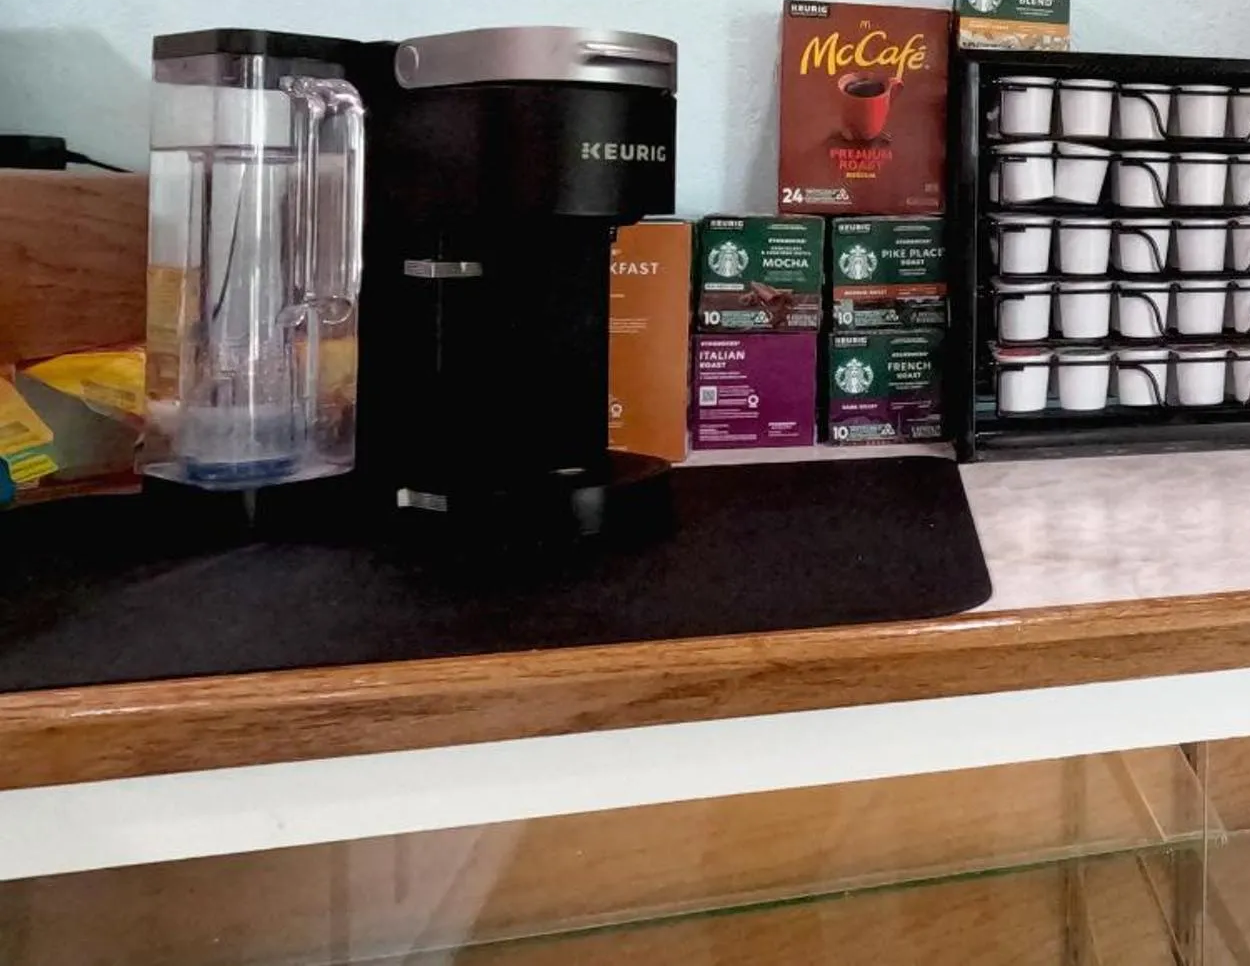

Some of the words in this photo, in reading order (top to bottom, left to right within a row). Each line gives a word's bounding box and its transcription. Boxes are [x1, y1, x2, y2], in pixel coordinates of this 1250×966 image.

[791, 3, 828, 13] KEURIG
[800, 30, 927, 80] McCafé
[582, 142, 666, 162] KEURIG
[829, 148, 893, 161] PREMIUM
[839, 160, 882, 171] ROAST
[782, 188, 804, 204] 24
[881, 248, 906, 259] PIKE
[610, 262, 660, 275] KFAST
[763, 258, 809, 268] MOCHA
[703, 311, 721, 326] 10
[838, 312, 854, 326] 10
[699, 350, 746, 361] ITALIAN
[887, 361, 932, 372] FRENCH
[832, 425, 849, 440] 10
